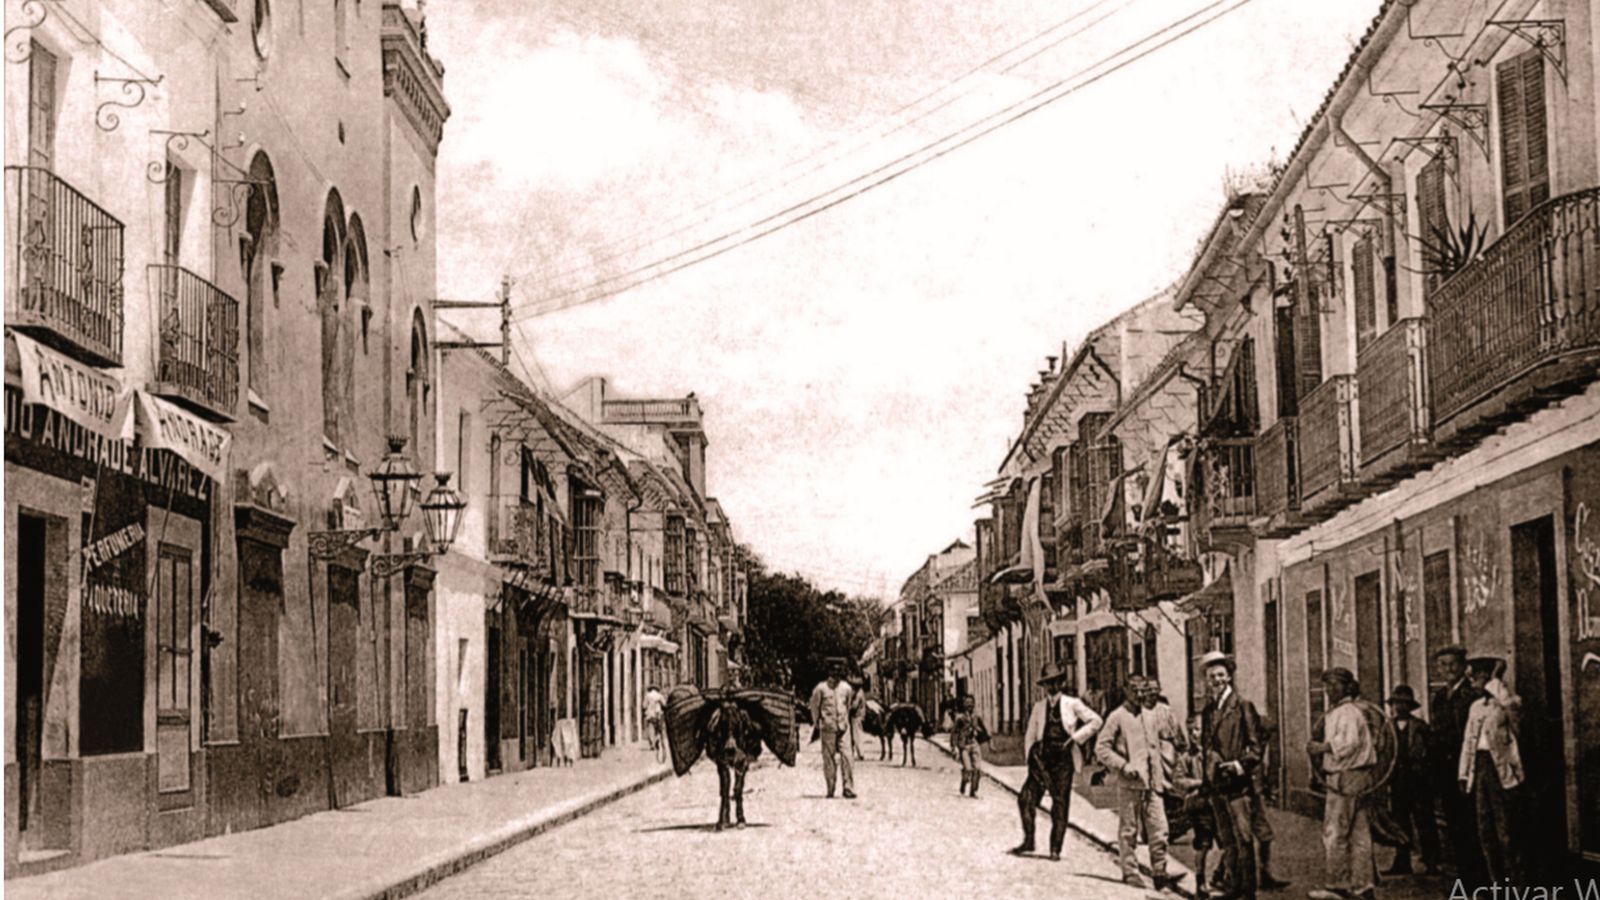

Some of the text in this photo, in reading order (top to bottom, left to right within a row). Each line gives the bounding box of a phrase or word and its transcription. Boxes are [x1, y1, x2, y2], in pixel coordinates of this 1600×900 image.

[34, 344, 116, 424] ANTONIO
[41, 407, 134, 475] ANDRADE
[138, 446, 207, 500] ALVAREZ
[82, 521, 146, 572] PERFUMERIA
